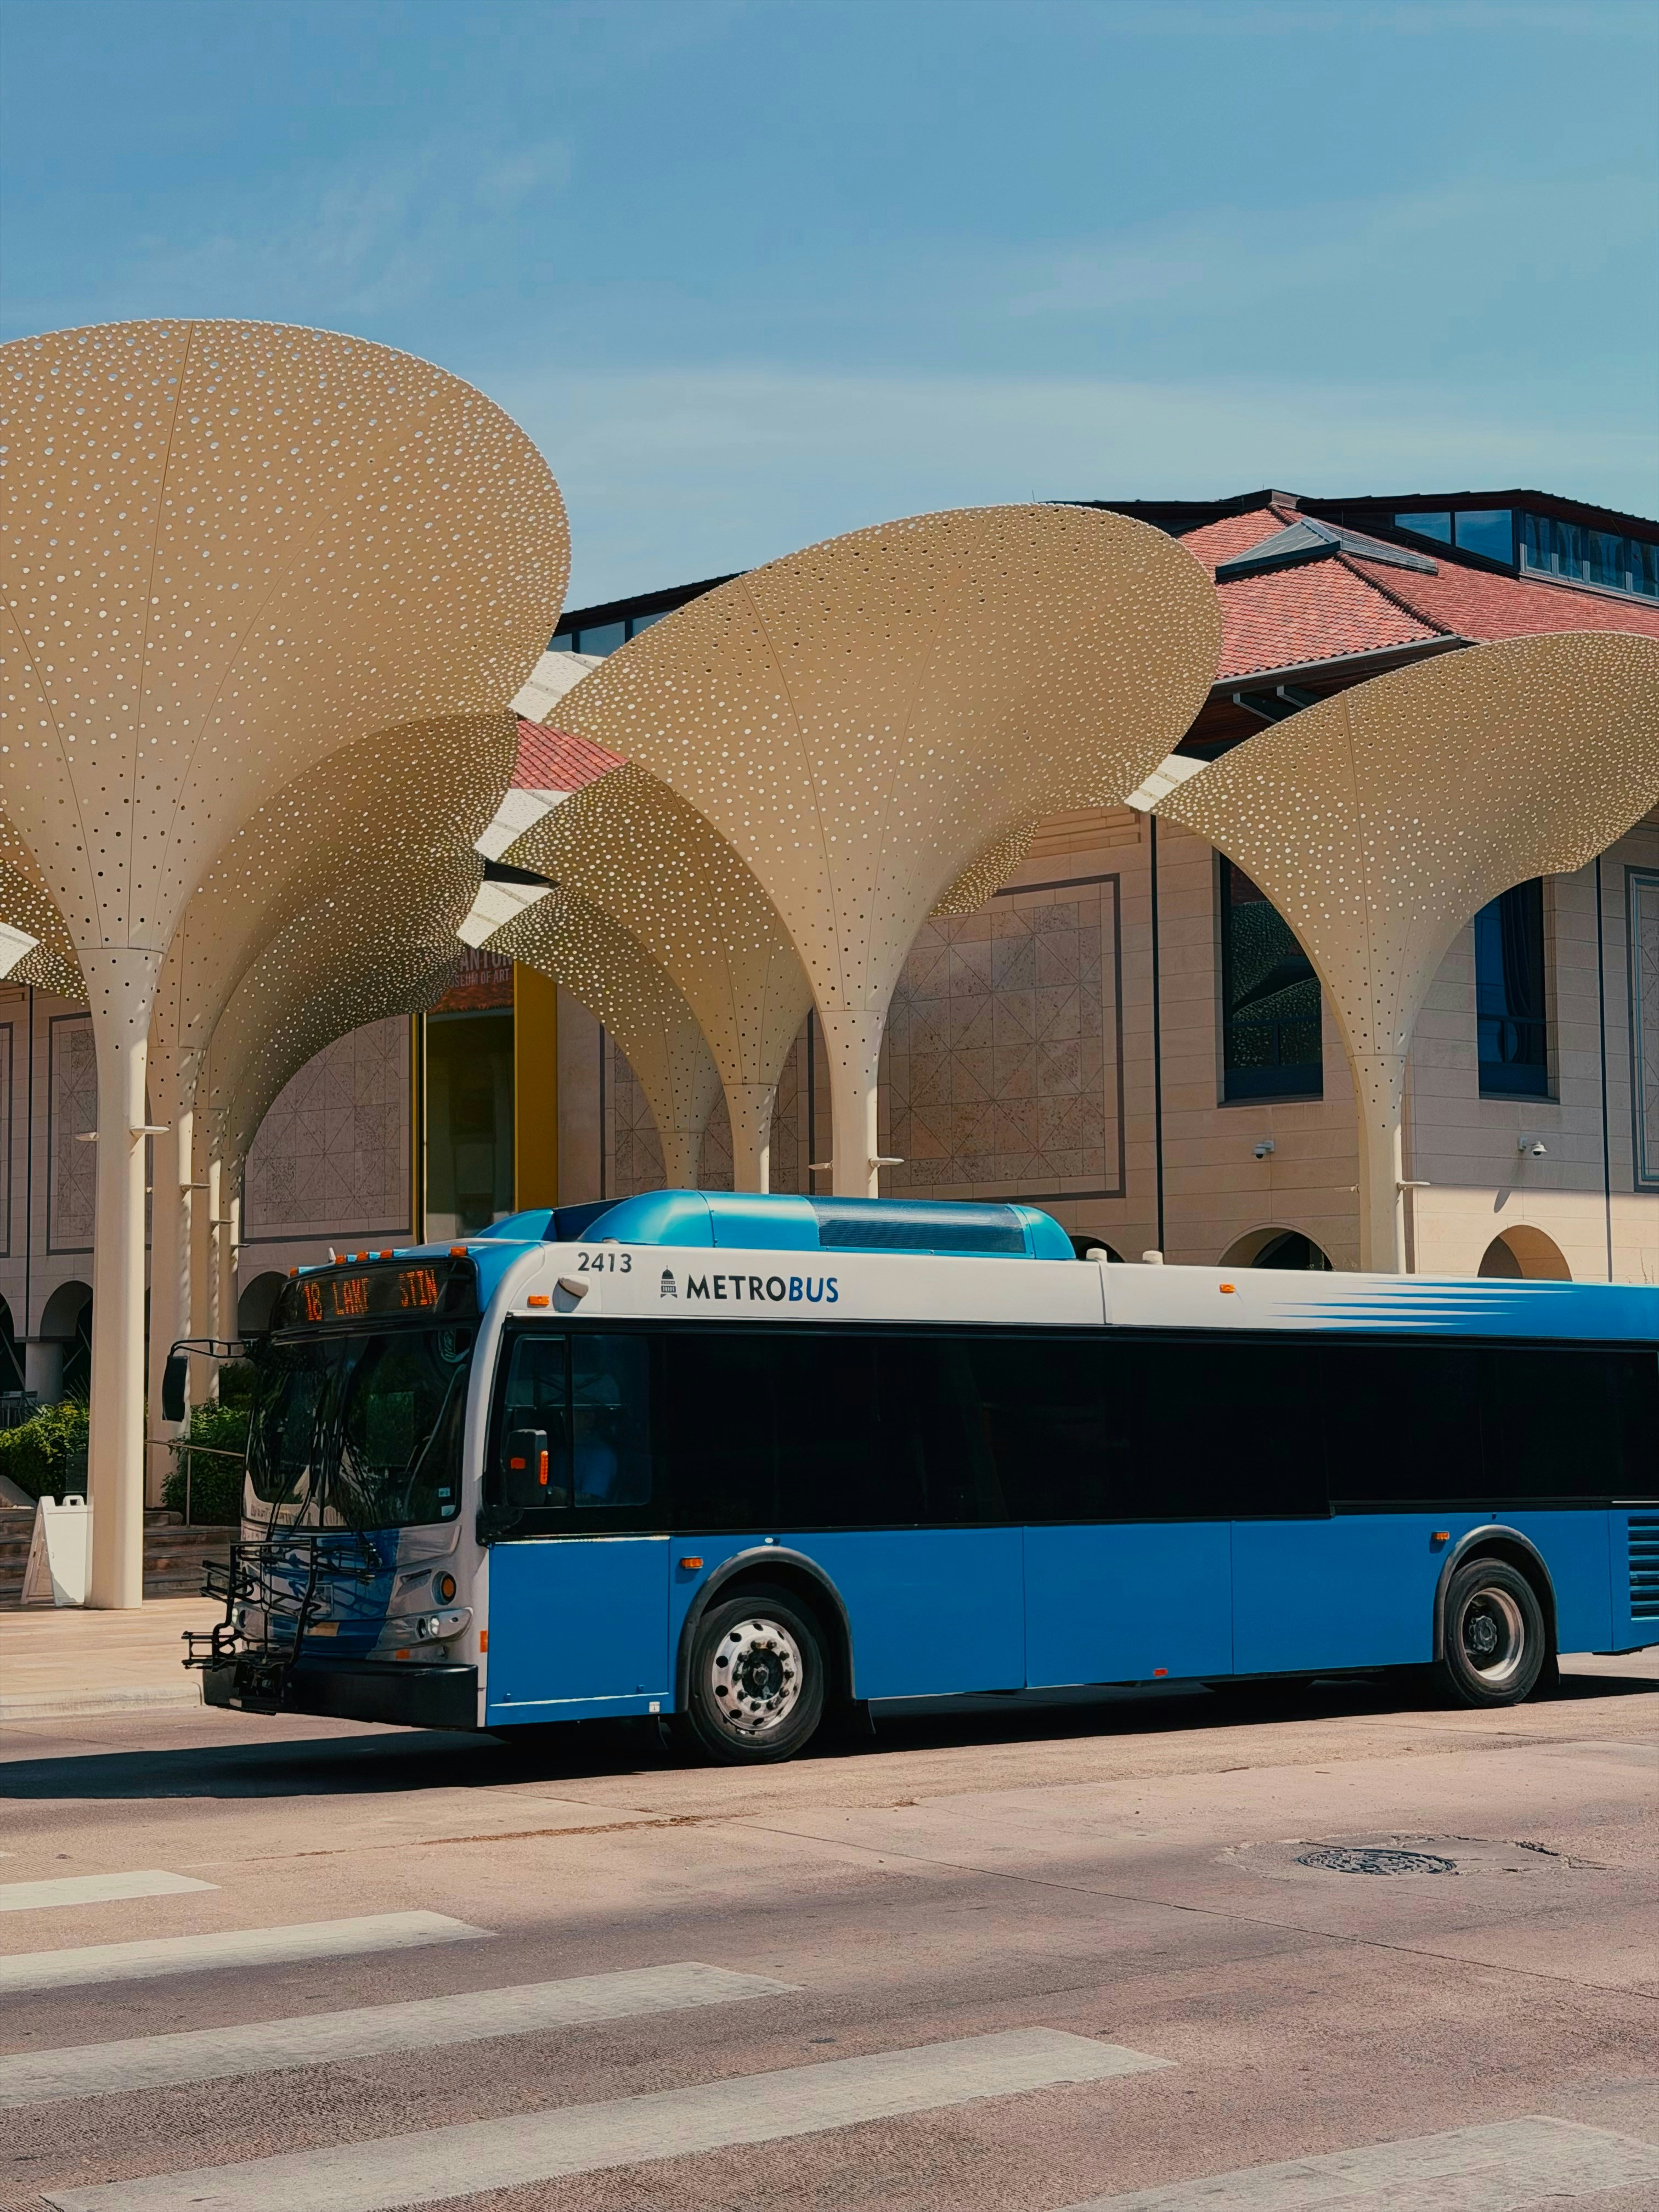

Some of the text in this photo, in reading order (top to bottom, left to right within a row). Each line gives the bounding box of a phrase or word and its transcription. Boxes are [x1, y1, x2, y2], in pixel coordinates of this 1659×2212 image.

[481, 971, 491, 984] OF
[493, 968, 510, 983] ART
[578, 1252, 632, 1273] 2413
[687, 1274, 839, 1303] METROBUS
